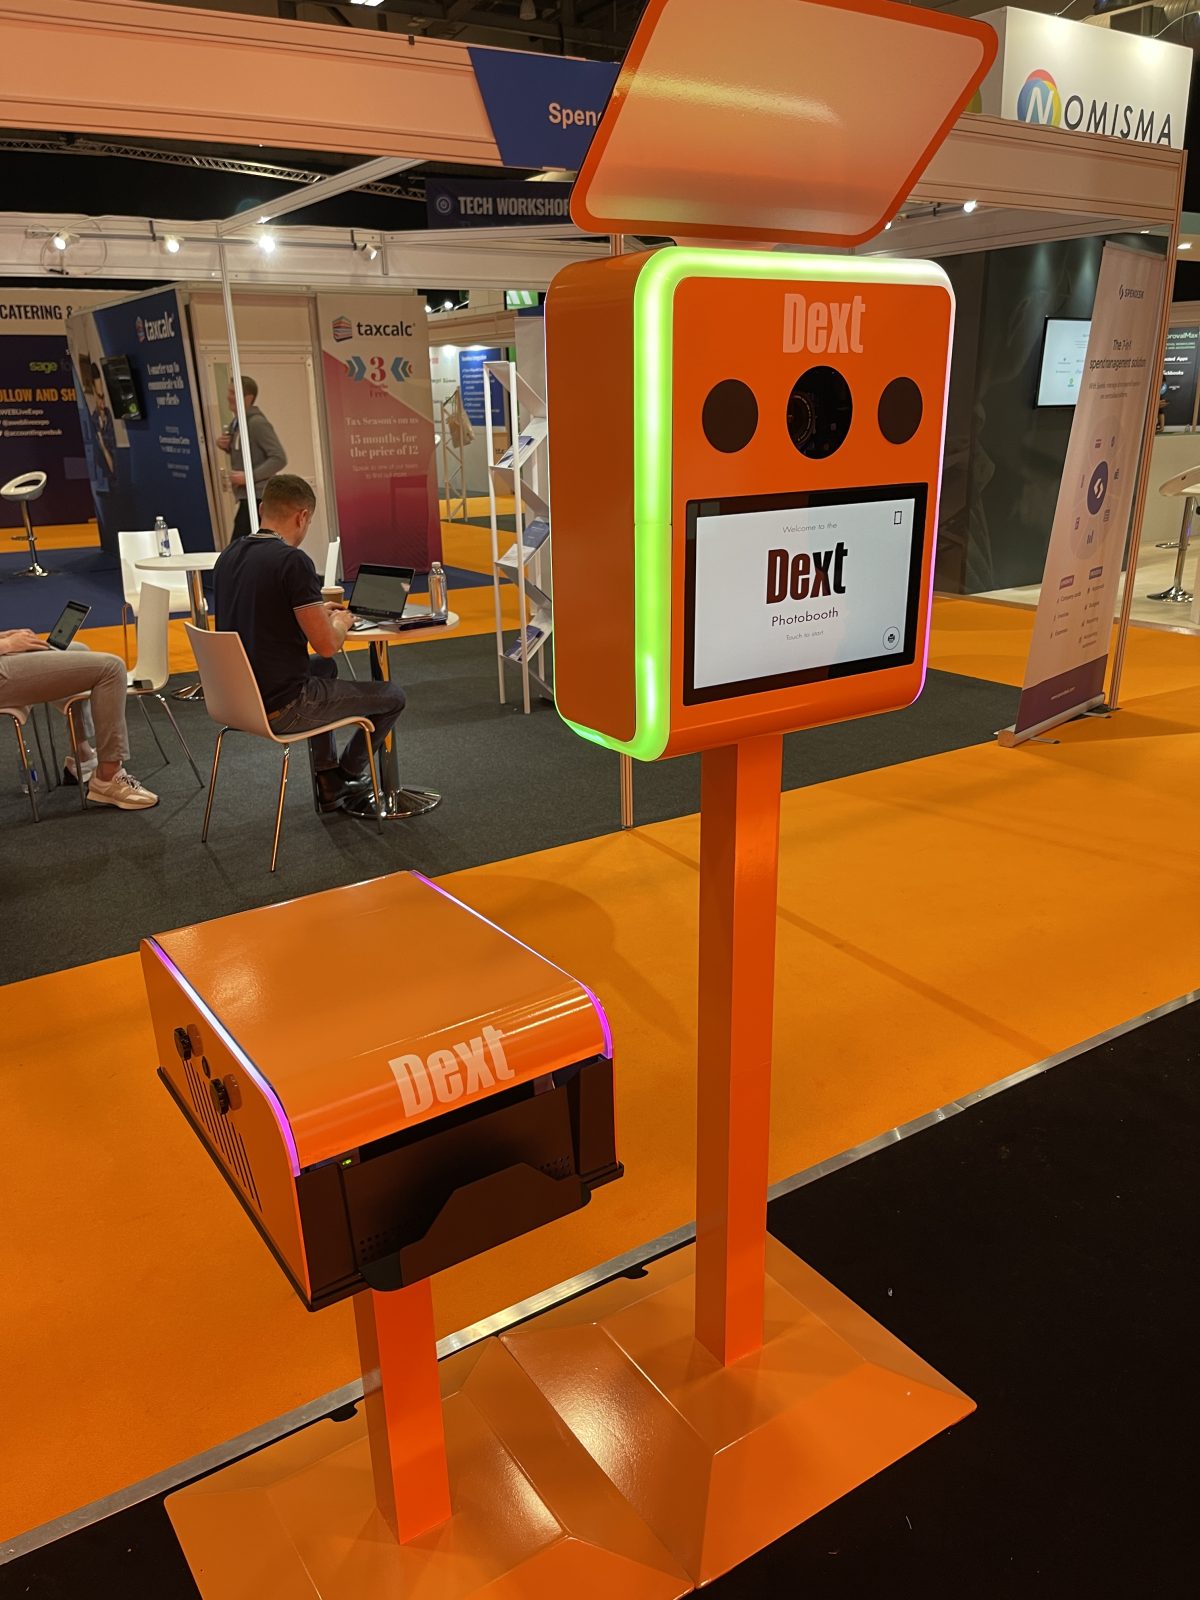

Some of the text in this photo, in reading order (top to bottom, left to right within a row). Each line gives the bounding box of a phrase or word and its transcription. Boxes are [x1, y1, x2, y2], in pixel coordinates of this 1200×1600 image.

[1026, 86, 1172, 145] NOMISMA
[458, 196, 493, 215] TECH
[0, 304, 62, 320] CATERING
[145, 311, 175, 341] taxcalc
[357, 321, 413, 336] taxcalc
[782, 293, 866, 354] Dext
[29, 361, 58, 373] sage
[369, 356, 387, 382] 3
[36, 388, 58, 402] AND
[350, 432, 418, 445] 15 months for
[350, 445, 419, 460] the price of 12
[782, 524, 816, 533] Welcome
[766, 541, 848, 604] Dext
[771, 607, 839, 627] Photobooth
[786, 633, 803, 641] Touch
[388, 1024, 516, 1118] Dext
